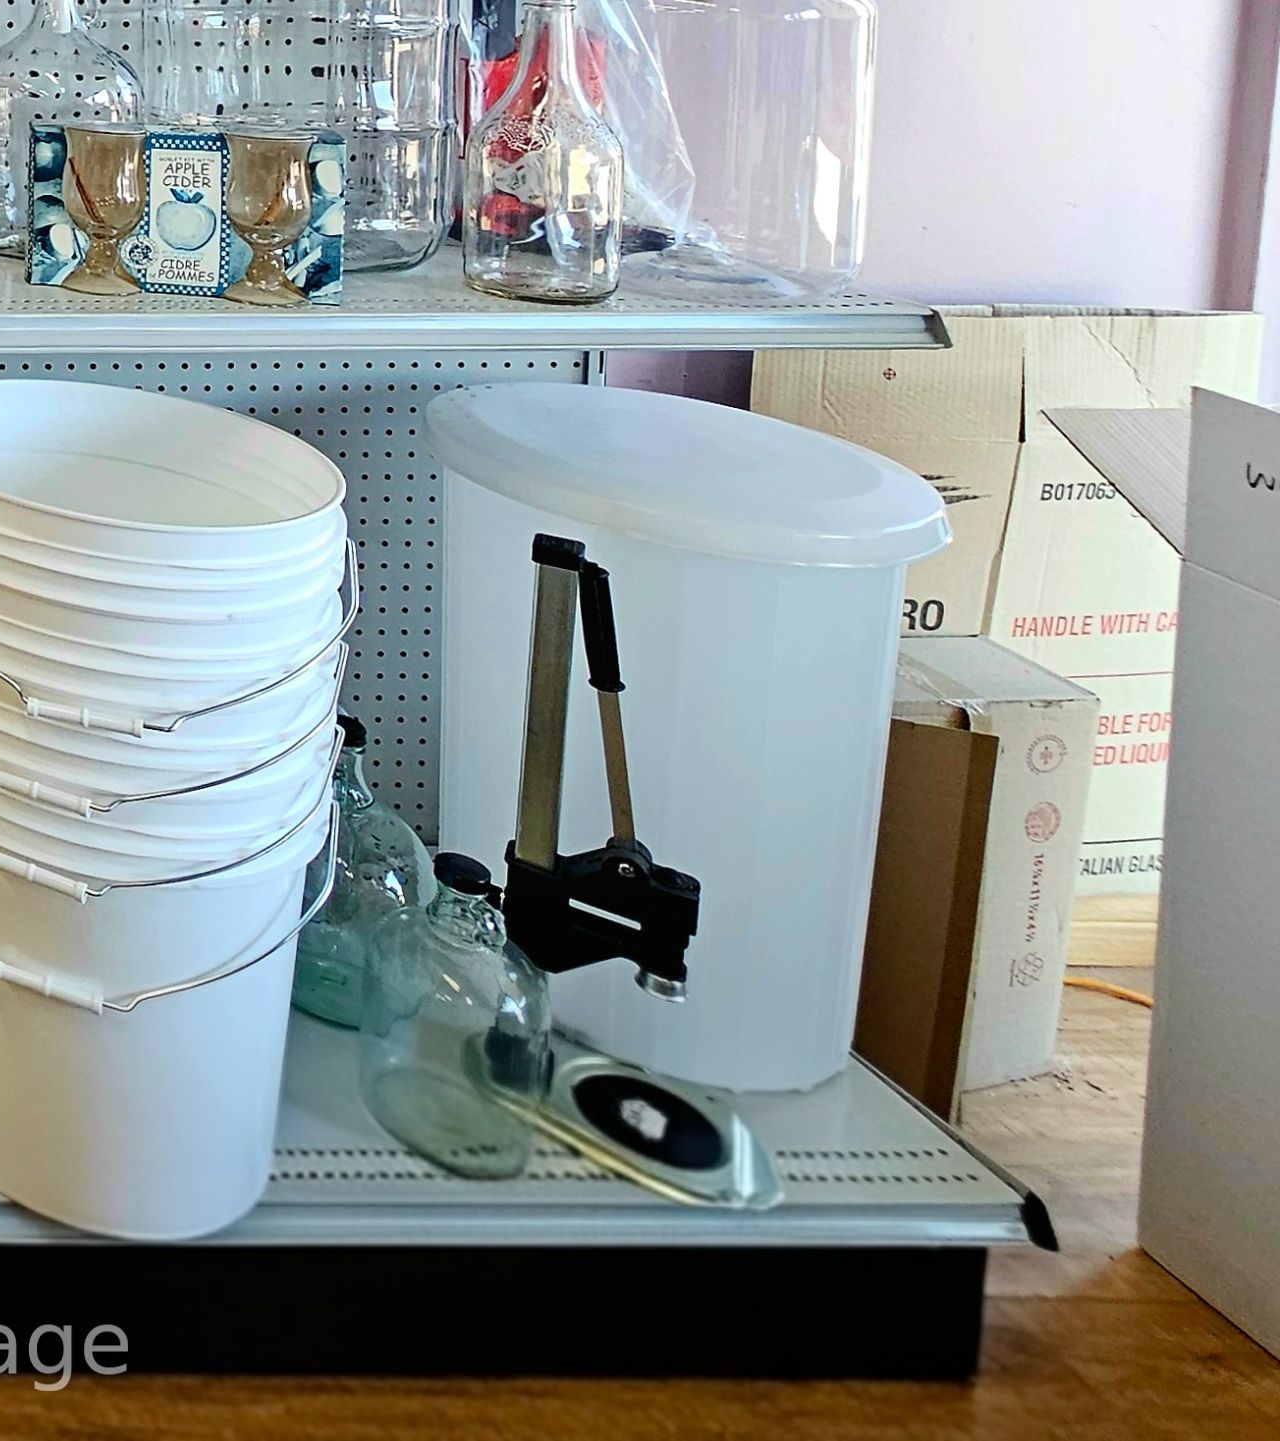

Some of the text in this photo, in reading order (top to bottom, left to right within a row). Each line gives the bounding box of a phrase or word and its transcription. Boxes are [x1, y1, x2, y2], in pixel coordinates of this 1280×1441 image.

[164, 162, 211, 176] APPLE
[162, 175, 211, 188] CIDER
[160, 259, 201, 271] CIDRE
[158, 269, 215, 283] POMMES
[1040, 482, 1117, 502] B017063
[1011, 614, 1094, 638] HANDLE
[1100, 613, 1149, 636] WITH
[1137, 711, 1173, 734] FOR
